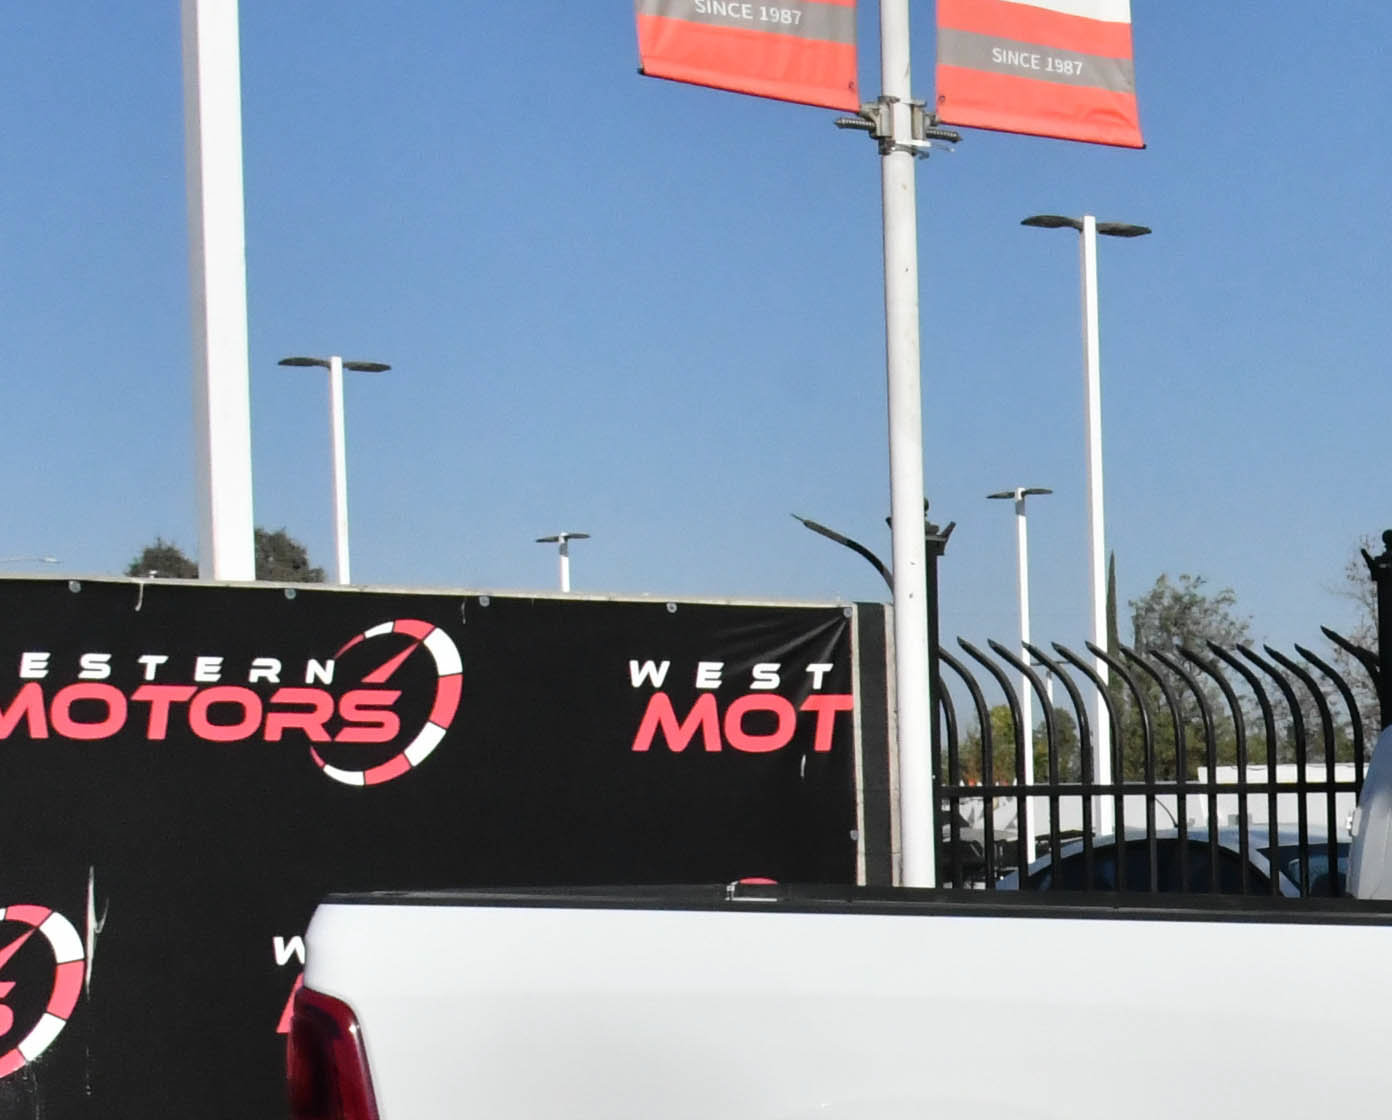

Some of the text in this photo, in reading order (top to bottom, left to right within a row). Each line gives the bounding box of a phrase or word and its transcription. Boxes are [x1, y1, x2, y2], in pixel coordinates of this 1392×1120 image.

[695, 0, 802, 25] SINCE 1987
[992, 47, 1083, 75] SINCE 1987
[629, 659, 834, 690] WEST
[0, 682, 403, 743] MOTORS
[631, 691, 854, 753] MOT
